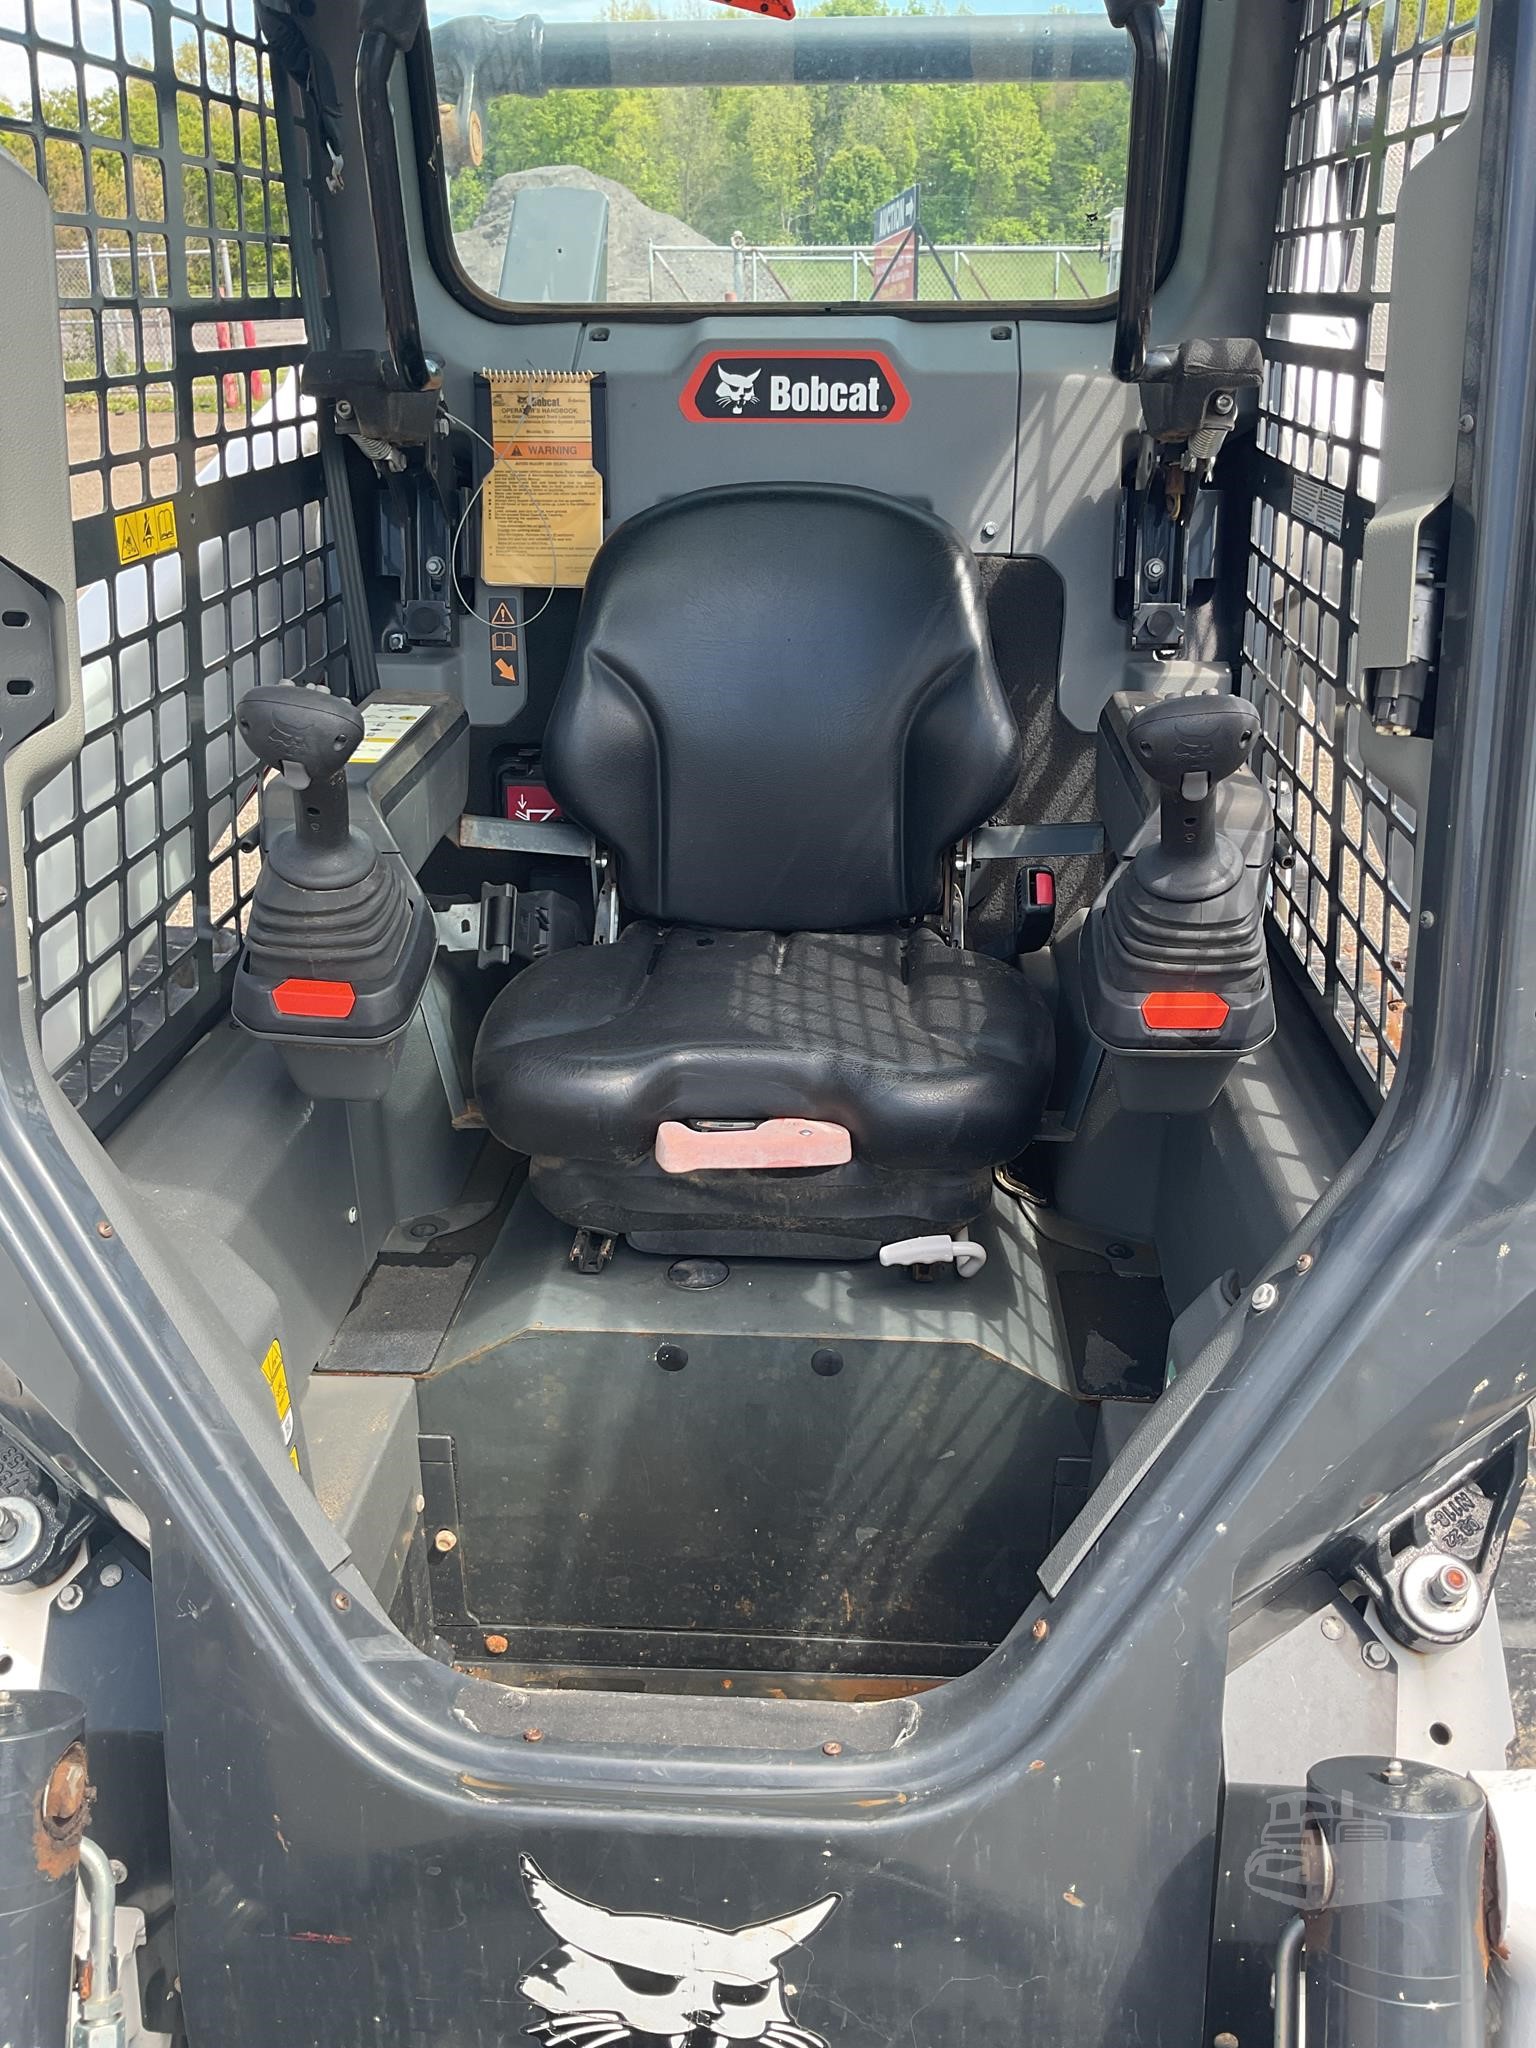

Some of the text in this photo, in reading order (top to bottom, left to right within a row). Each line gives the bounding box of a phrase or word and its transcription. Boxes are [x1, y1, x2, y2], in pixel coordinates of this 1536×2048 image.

[770, 375, 880, 412] Bobcat
[542, 407, 578, 415] HANDBOOK
[528, 445, 577, 455] WARNING
